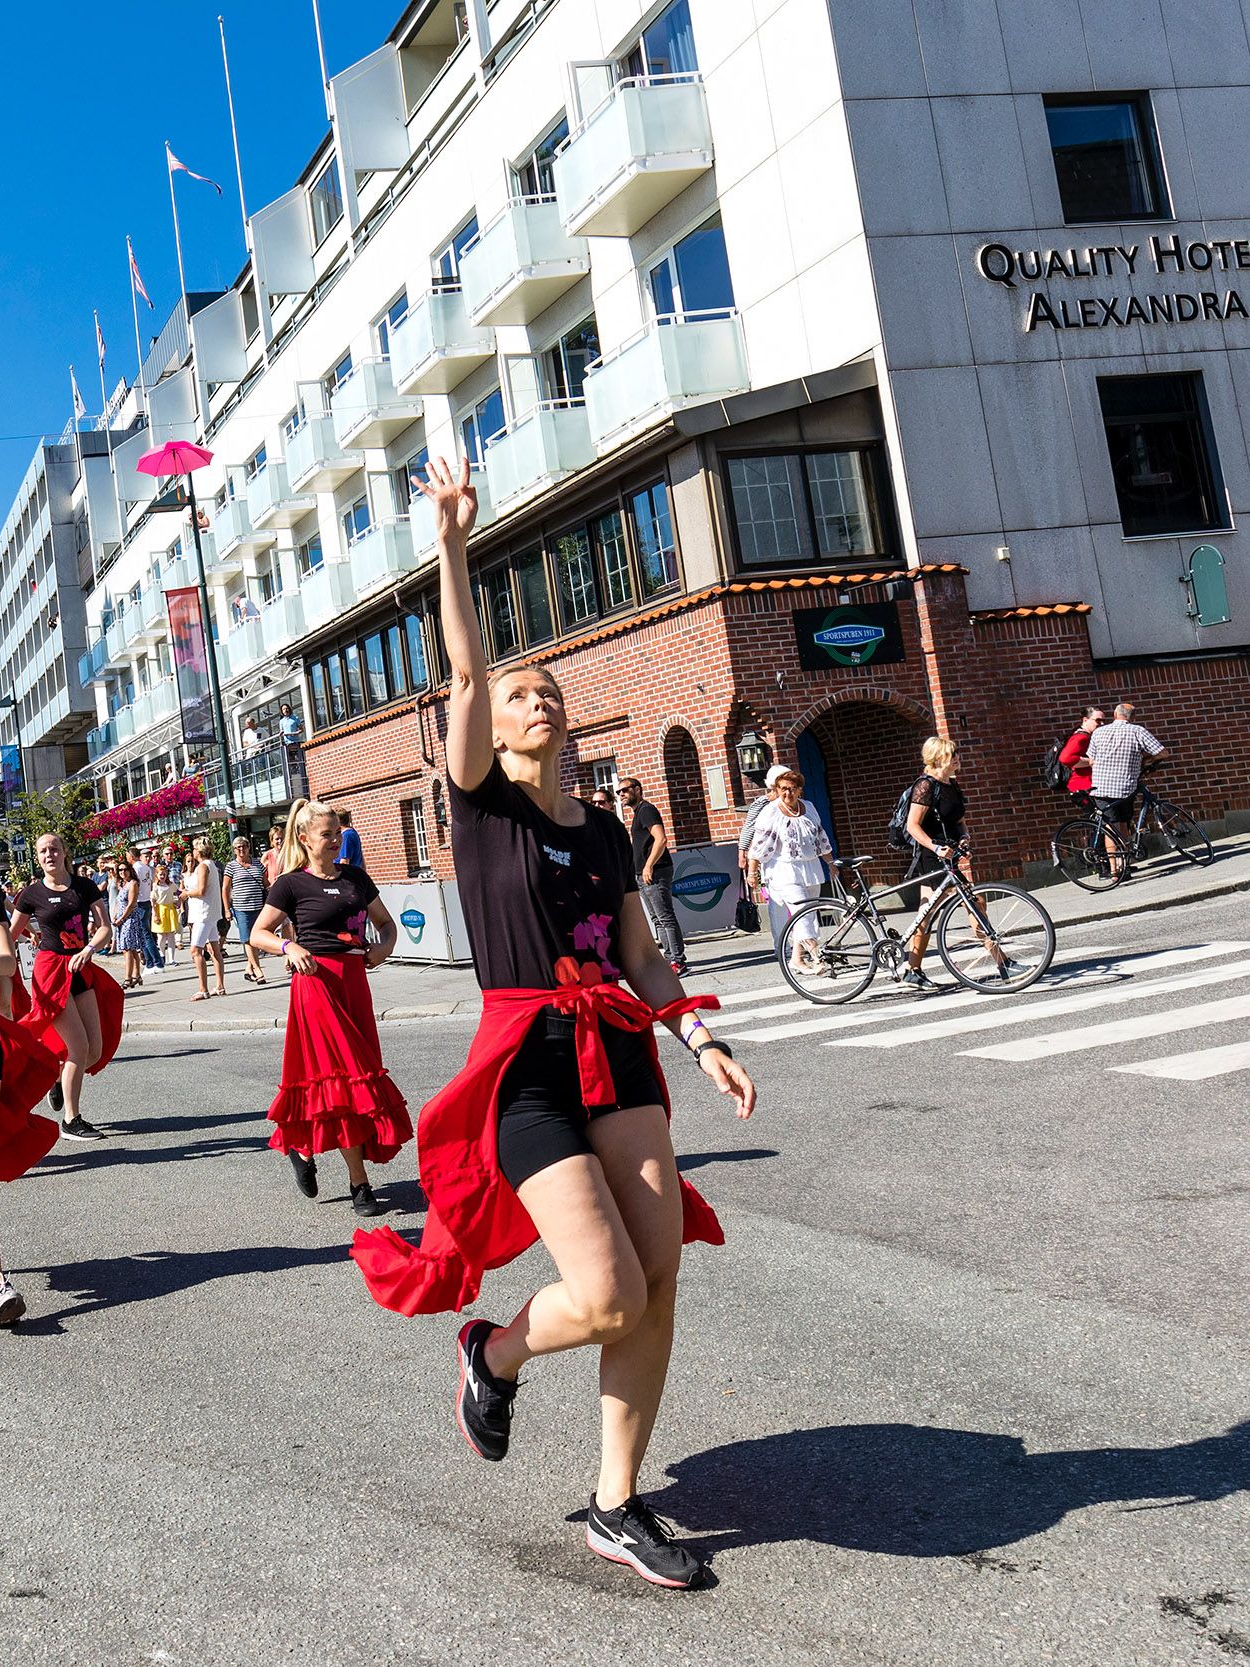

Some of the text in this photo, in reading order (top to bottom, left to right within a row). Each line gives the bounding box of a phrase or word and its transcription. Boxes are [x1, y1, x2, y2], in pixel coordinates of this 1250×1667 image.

[976, 242, 1139, 289] QUALITY
[1024, 290, 1250, 333] ALEXANDRA
[823, 629, 875, 640] SPORTSPUBEN 1911
